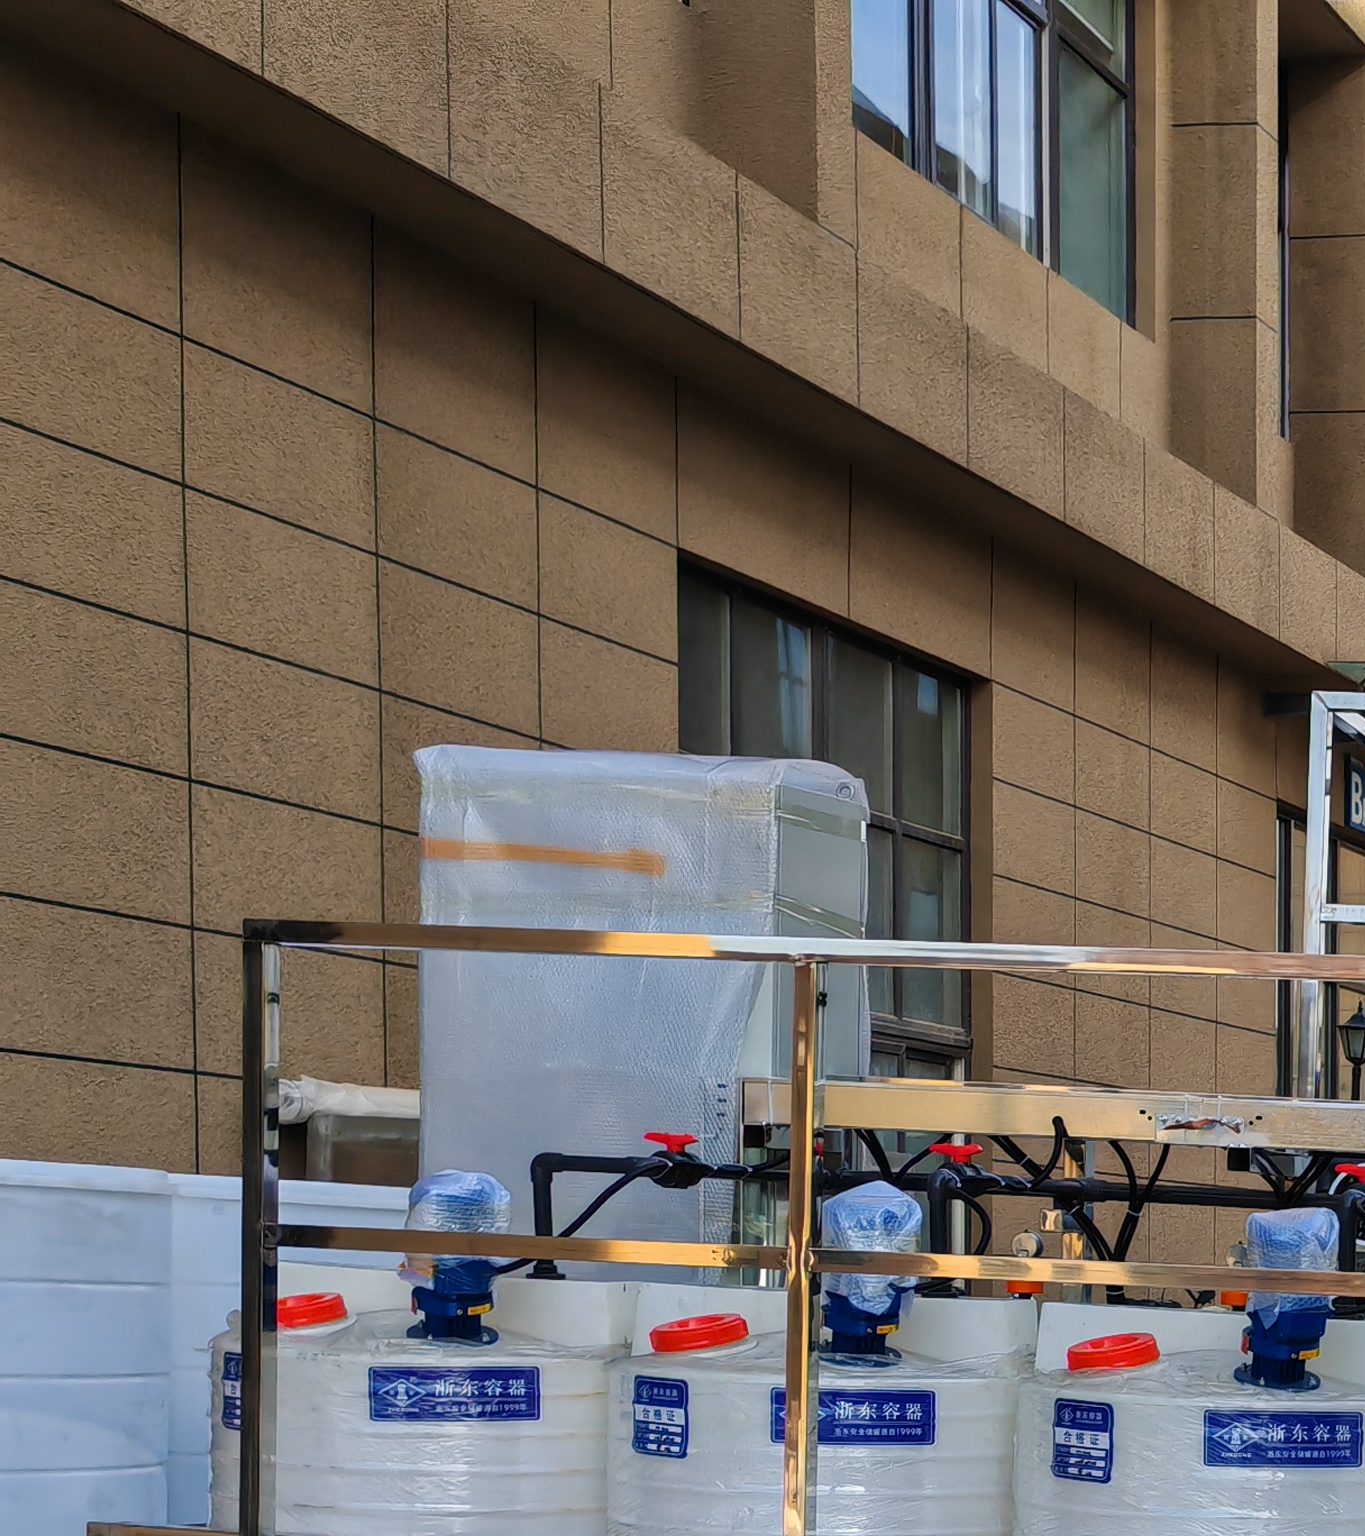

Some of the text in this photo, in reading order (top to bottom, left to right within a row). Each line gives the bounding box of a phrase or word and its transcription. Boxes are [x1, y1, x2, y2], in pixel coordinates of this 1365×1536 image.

[434, 1379, 527, 1397] 浙东容器
[834, 1401, 923, 1420] 浙东容器
[1063, 1430, 1100, 1446] 合格证
[1267, 1423, 1352, 1442] 浙东容器
